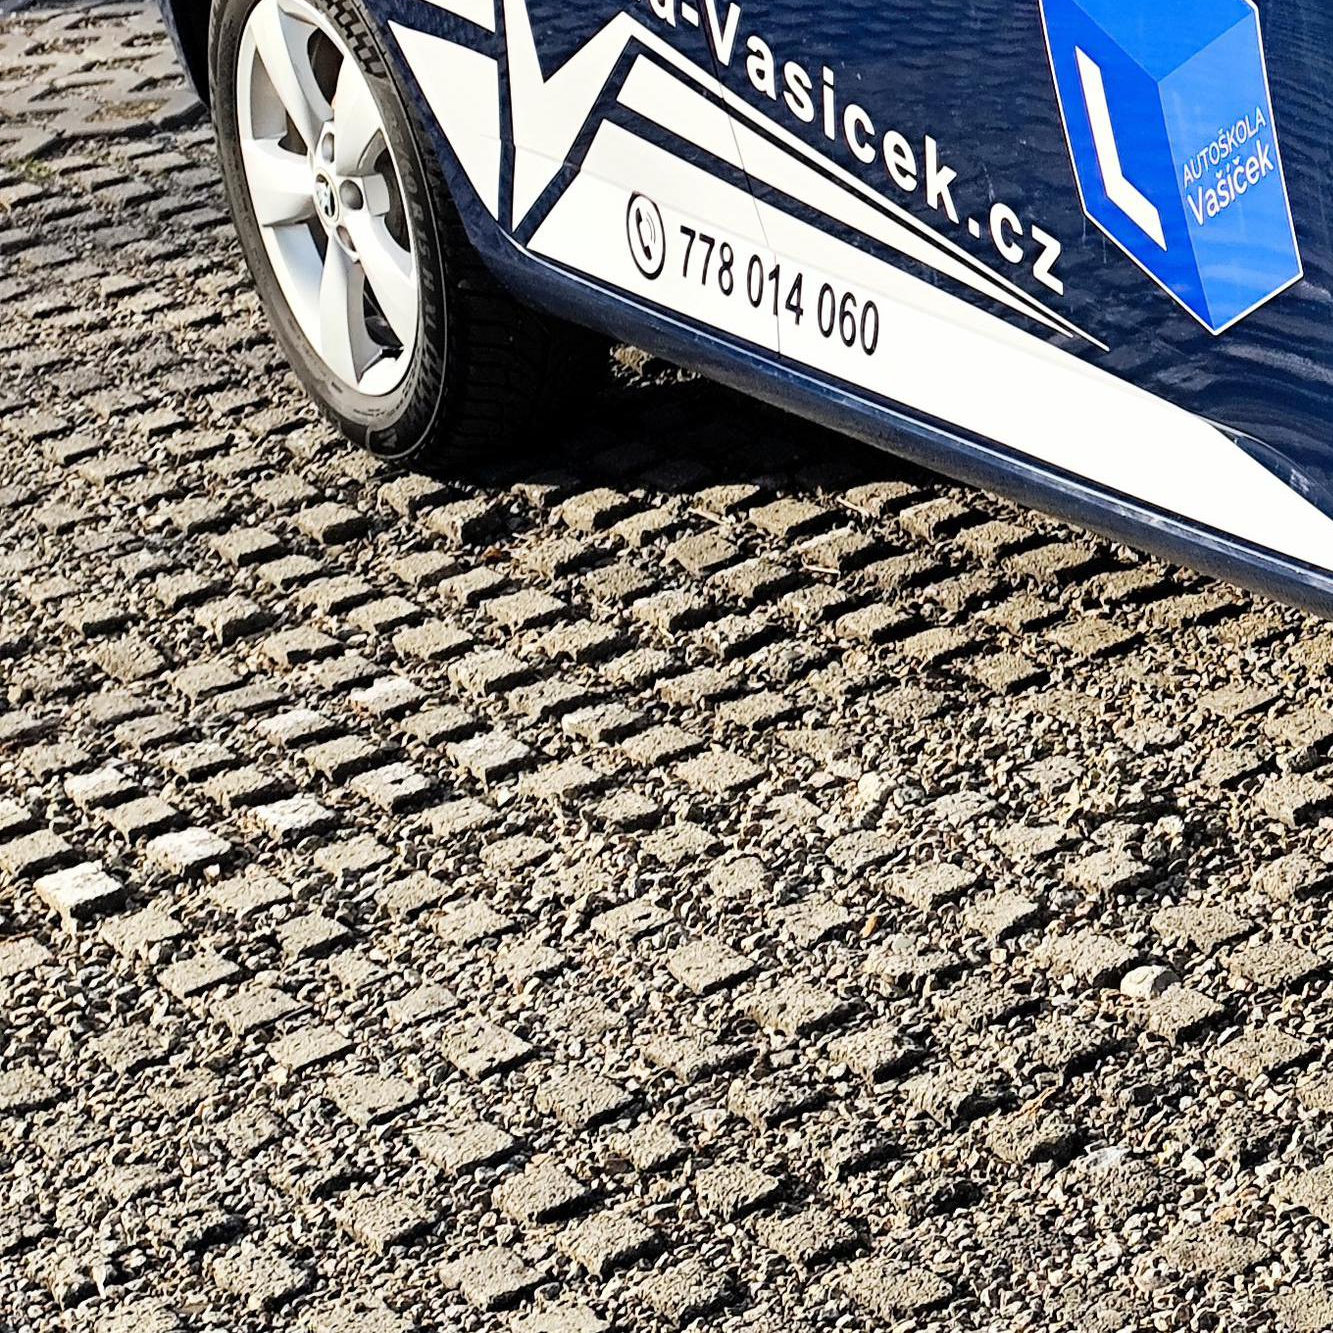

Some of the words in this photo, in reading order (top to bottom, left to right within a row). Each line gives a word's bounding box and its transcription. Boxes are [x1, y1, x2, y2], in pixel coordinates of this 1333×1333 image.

[1183, 105, 1267, 191] AUTOŠKOLA
[1187, 139, 1274, 227] Vašíček
[680, 224, 734, 296] 778
[746, 254, 804, 326] 014
[817, 282, 880, 356] 060
